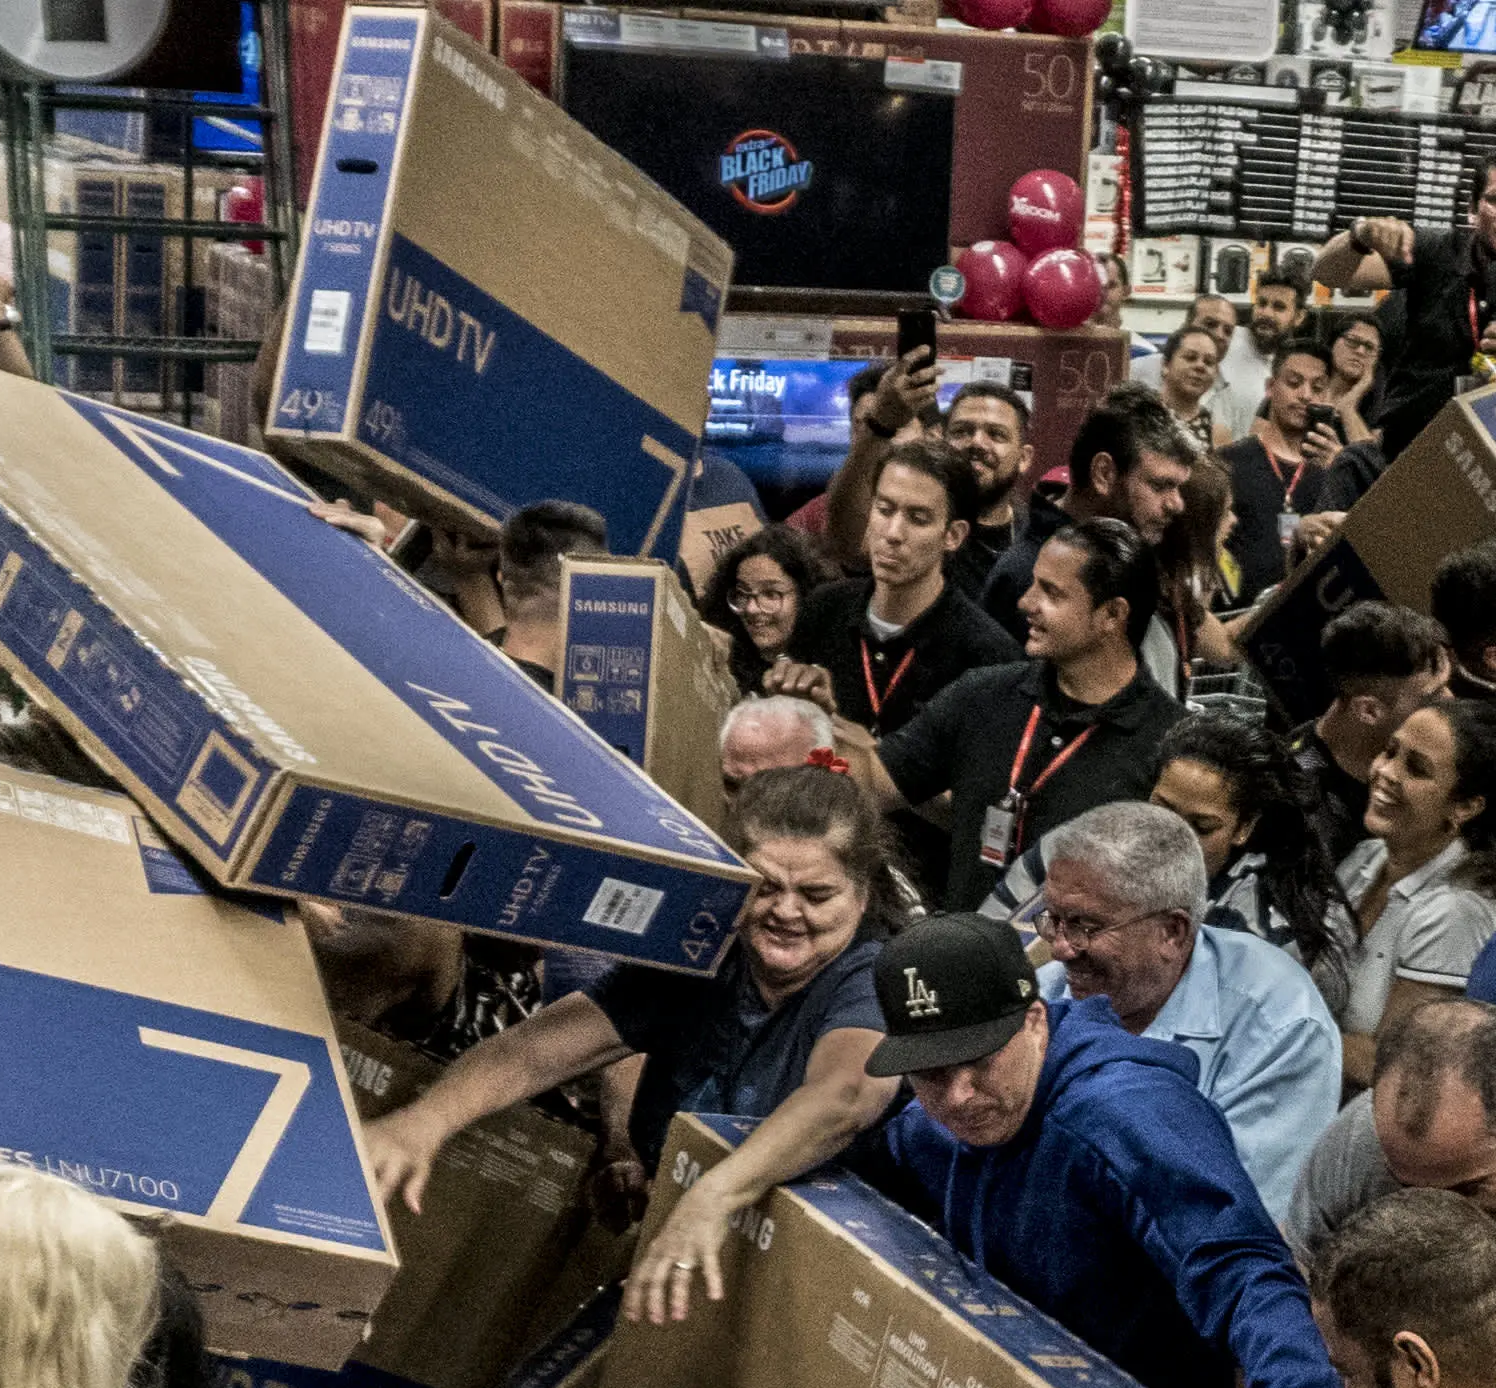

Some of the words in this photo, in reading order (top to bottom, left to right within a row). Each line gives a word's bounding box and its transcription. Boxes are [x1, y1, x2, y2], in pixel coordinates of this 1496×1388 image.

[1024, 54, 1075, 99] 50
[720, 146, 787, 187] BLACK
[748, 161, 813, 201] FRIDAY
[314, 219, 354, 238] UHD
[355, 221, 376, 239] TV
[387, 264, 456, 351] UHD
[457, 310, 497, 378] TV
[730, 369, 787, 397] Friday
[1057, 350, 1111, 393] 50
[703, 524, 746, 551] TAKE
[573, 598, 649, 615] SAMSUNG
[405, 680, 500, 737] TV
[476, 740, 605, 830] UHD
[280, 798, 334, 883] SAMSUNG
[903, 967, 941, 1019] LA
[136, 1025, 313, 1224] 7
[888, 1332, 939, 1380] RESOLUTION
